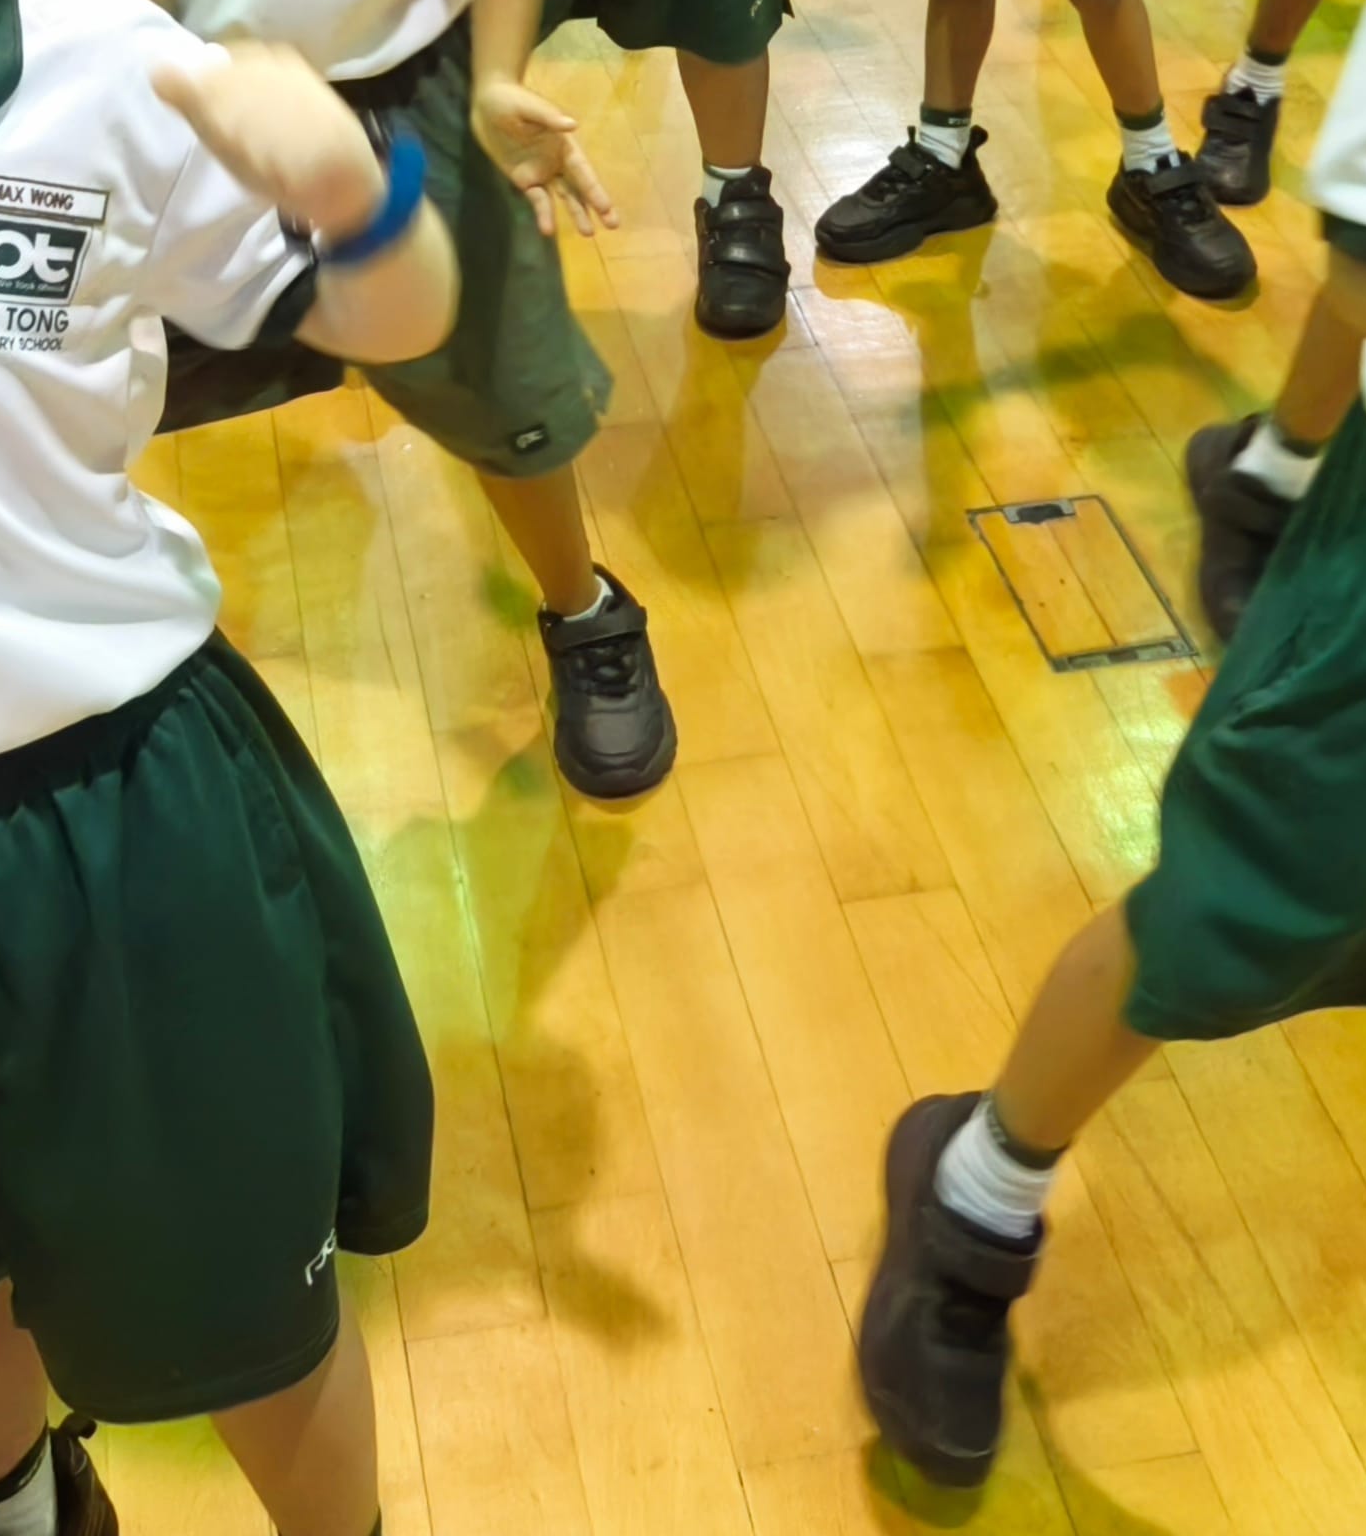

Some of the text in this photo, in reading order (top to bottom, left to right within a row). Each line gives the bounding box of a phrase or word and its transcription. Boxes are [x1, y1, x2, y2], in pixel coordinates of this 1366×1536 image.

[30, 188, 74, 211] WONG
[6, 306, 69, 334] TONG
[18, 336, 64, 352] SCHOOL
